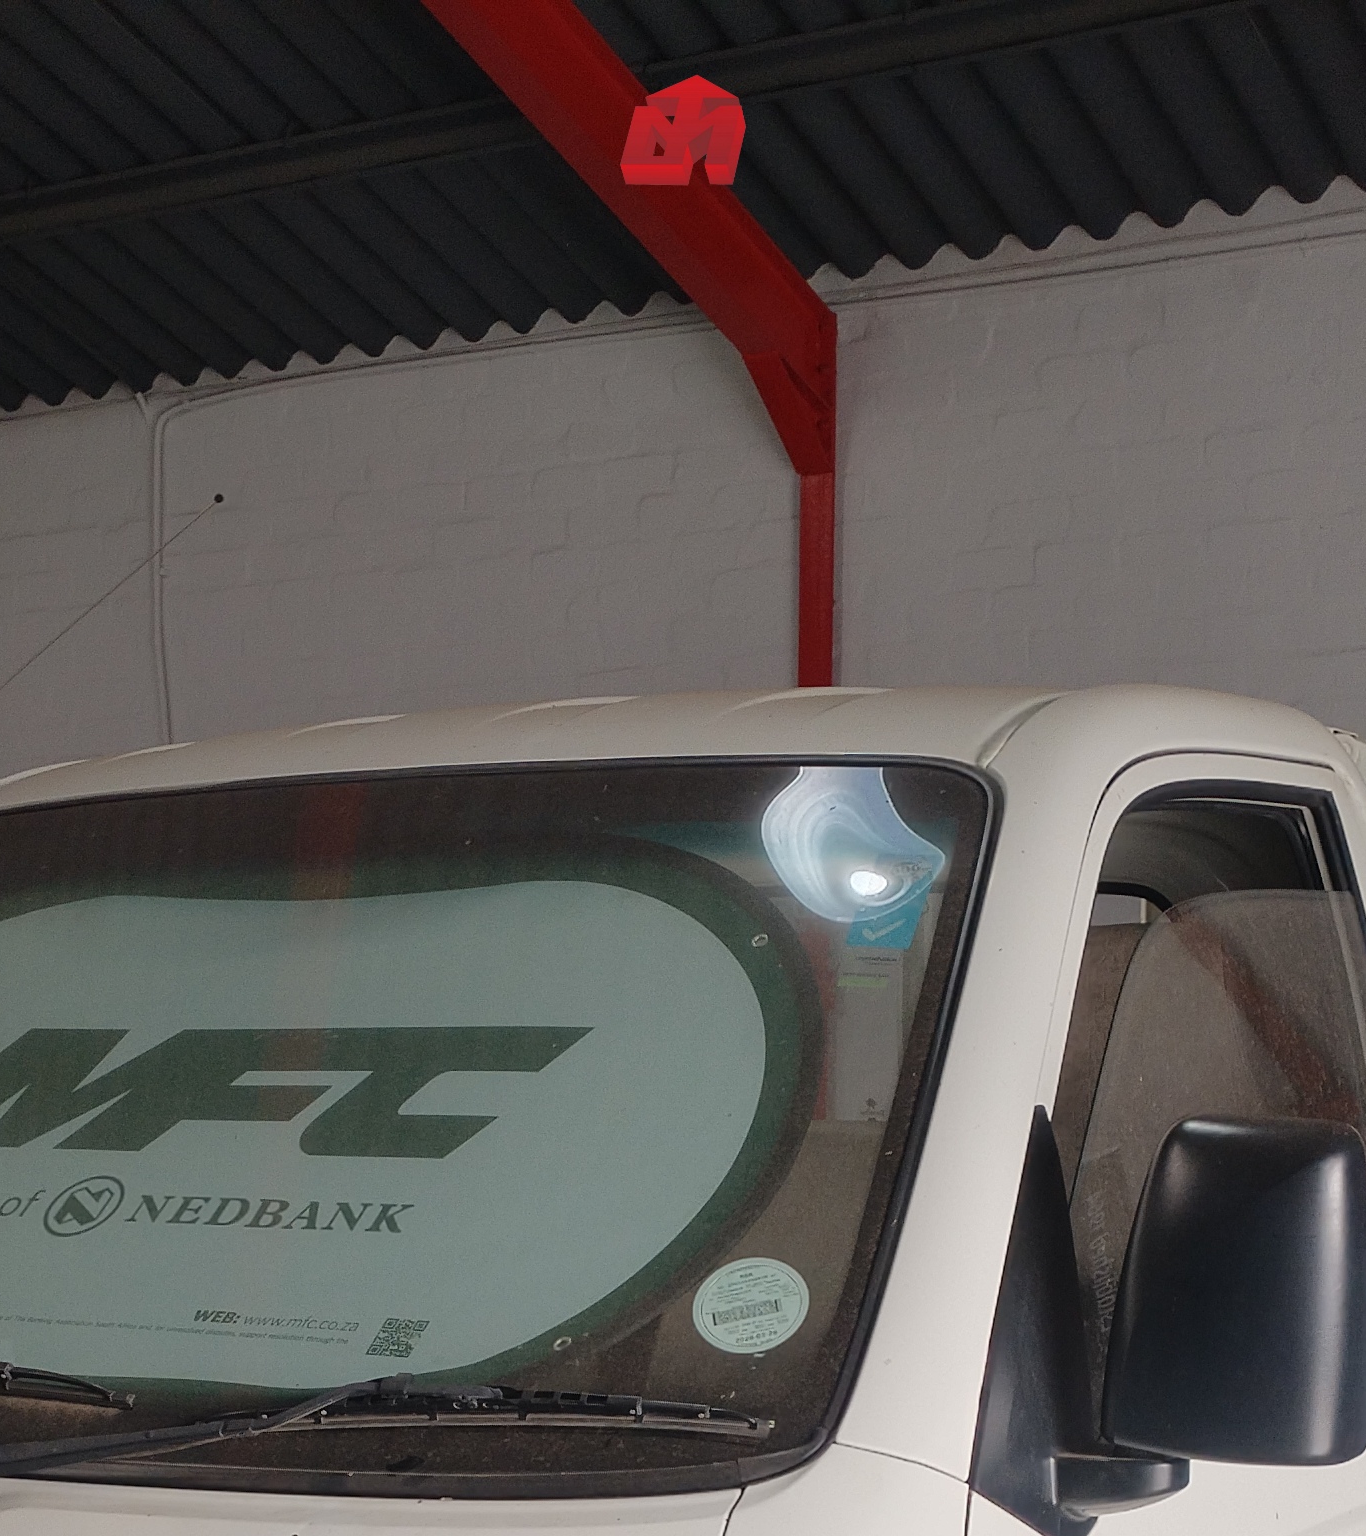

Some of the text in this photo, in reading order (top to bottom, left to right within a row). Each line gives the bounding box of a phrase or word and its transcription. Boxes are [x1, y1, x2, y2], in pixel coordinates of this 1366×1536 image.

[0, 1189, 46, 1217] of
[125, 1194, 415, 1234] NEDBANK
[193, 1309, 360, 1332] WEB: www.mfc.co.za
